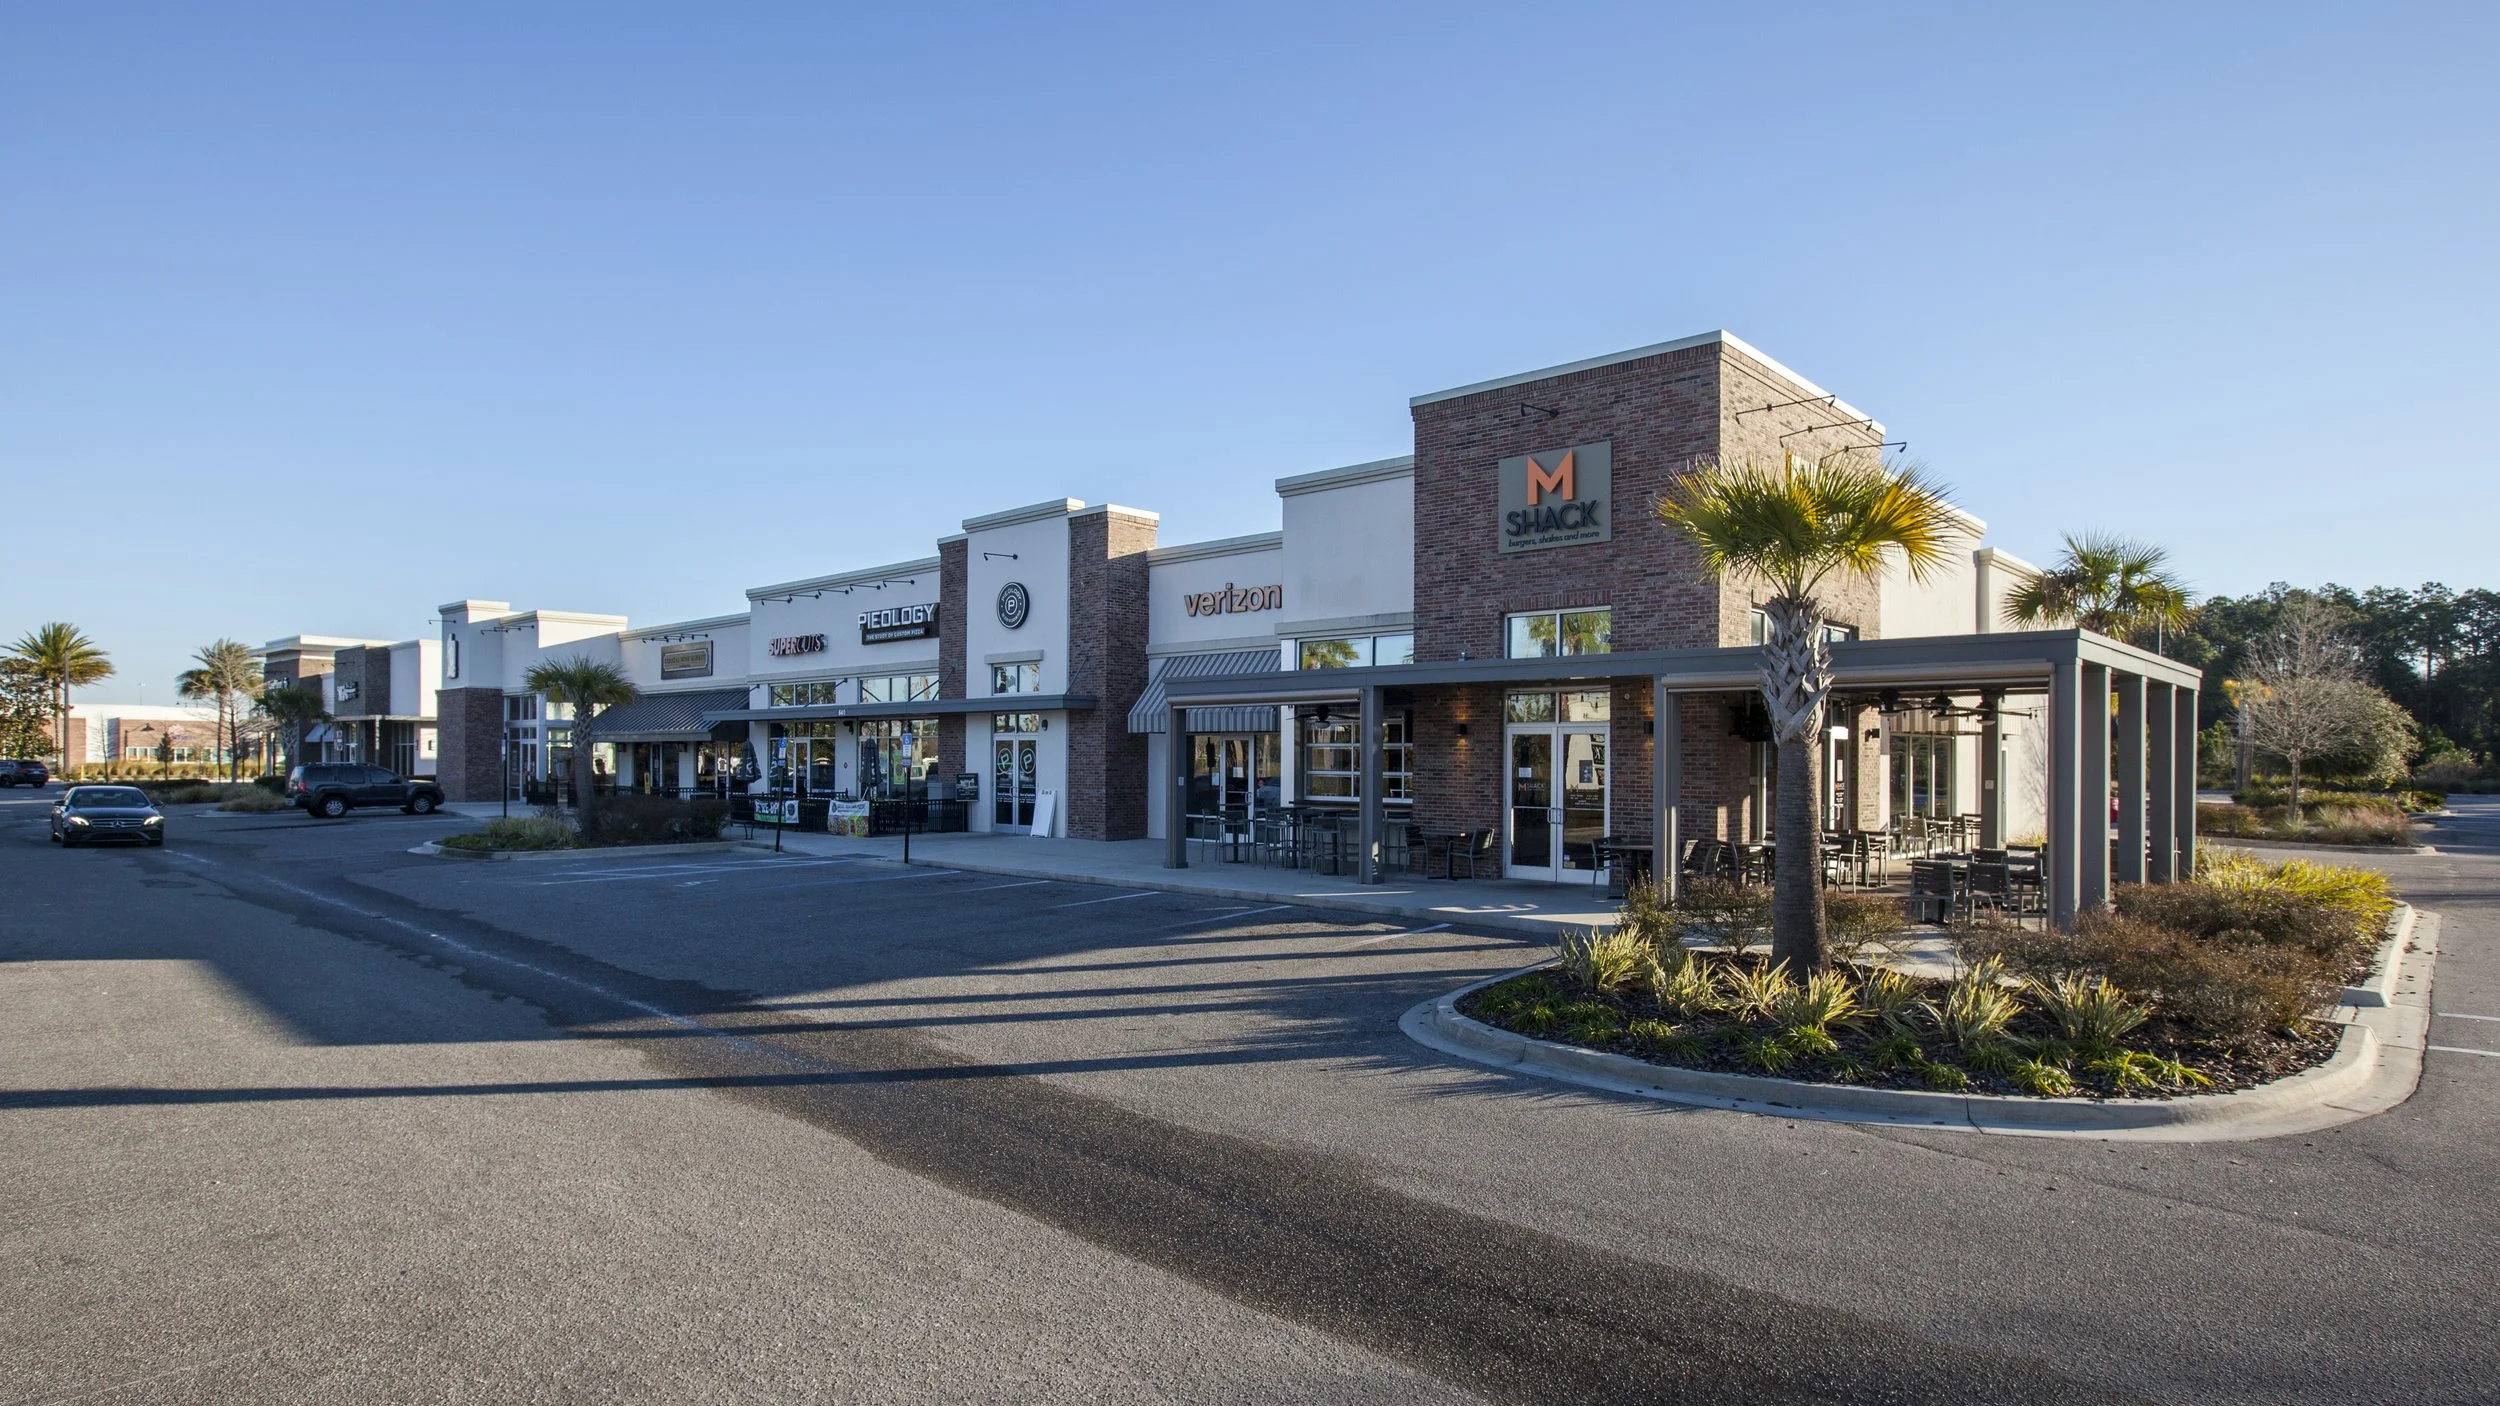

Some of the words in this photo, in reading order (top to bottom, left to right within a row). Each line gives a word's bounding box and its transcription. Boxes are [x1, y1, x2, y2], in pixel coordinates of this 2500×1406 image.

[1527, 447, 1574, 506] M
[1505, 499, 1600, 537] SHACK
[1539, 534, 1563, 544] shakes
[1564, 531, 1579, 541] and
[1580, 531, 1600, 539] more
[1007, 599, 1015, 611] P
[1184, 582, 1282, 617] verizon
[857, 603, 935, 630] PIEOLOGY
[769, 634, 824, 656] SUPERCUTS
